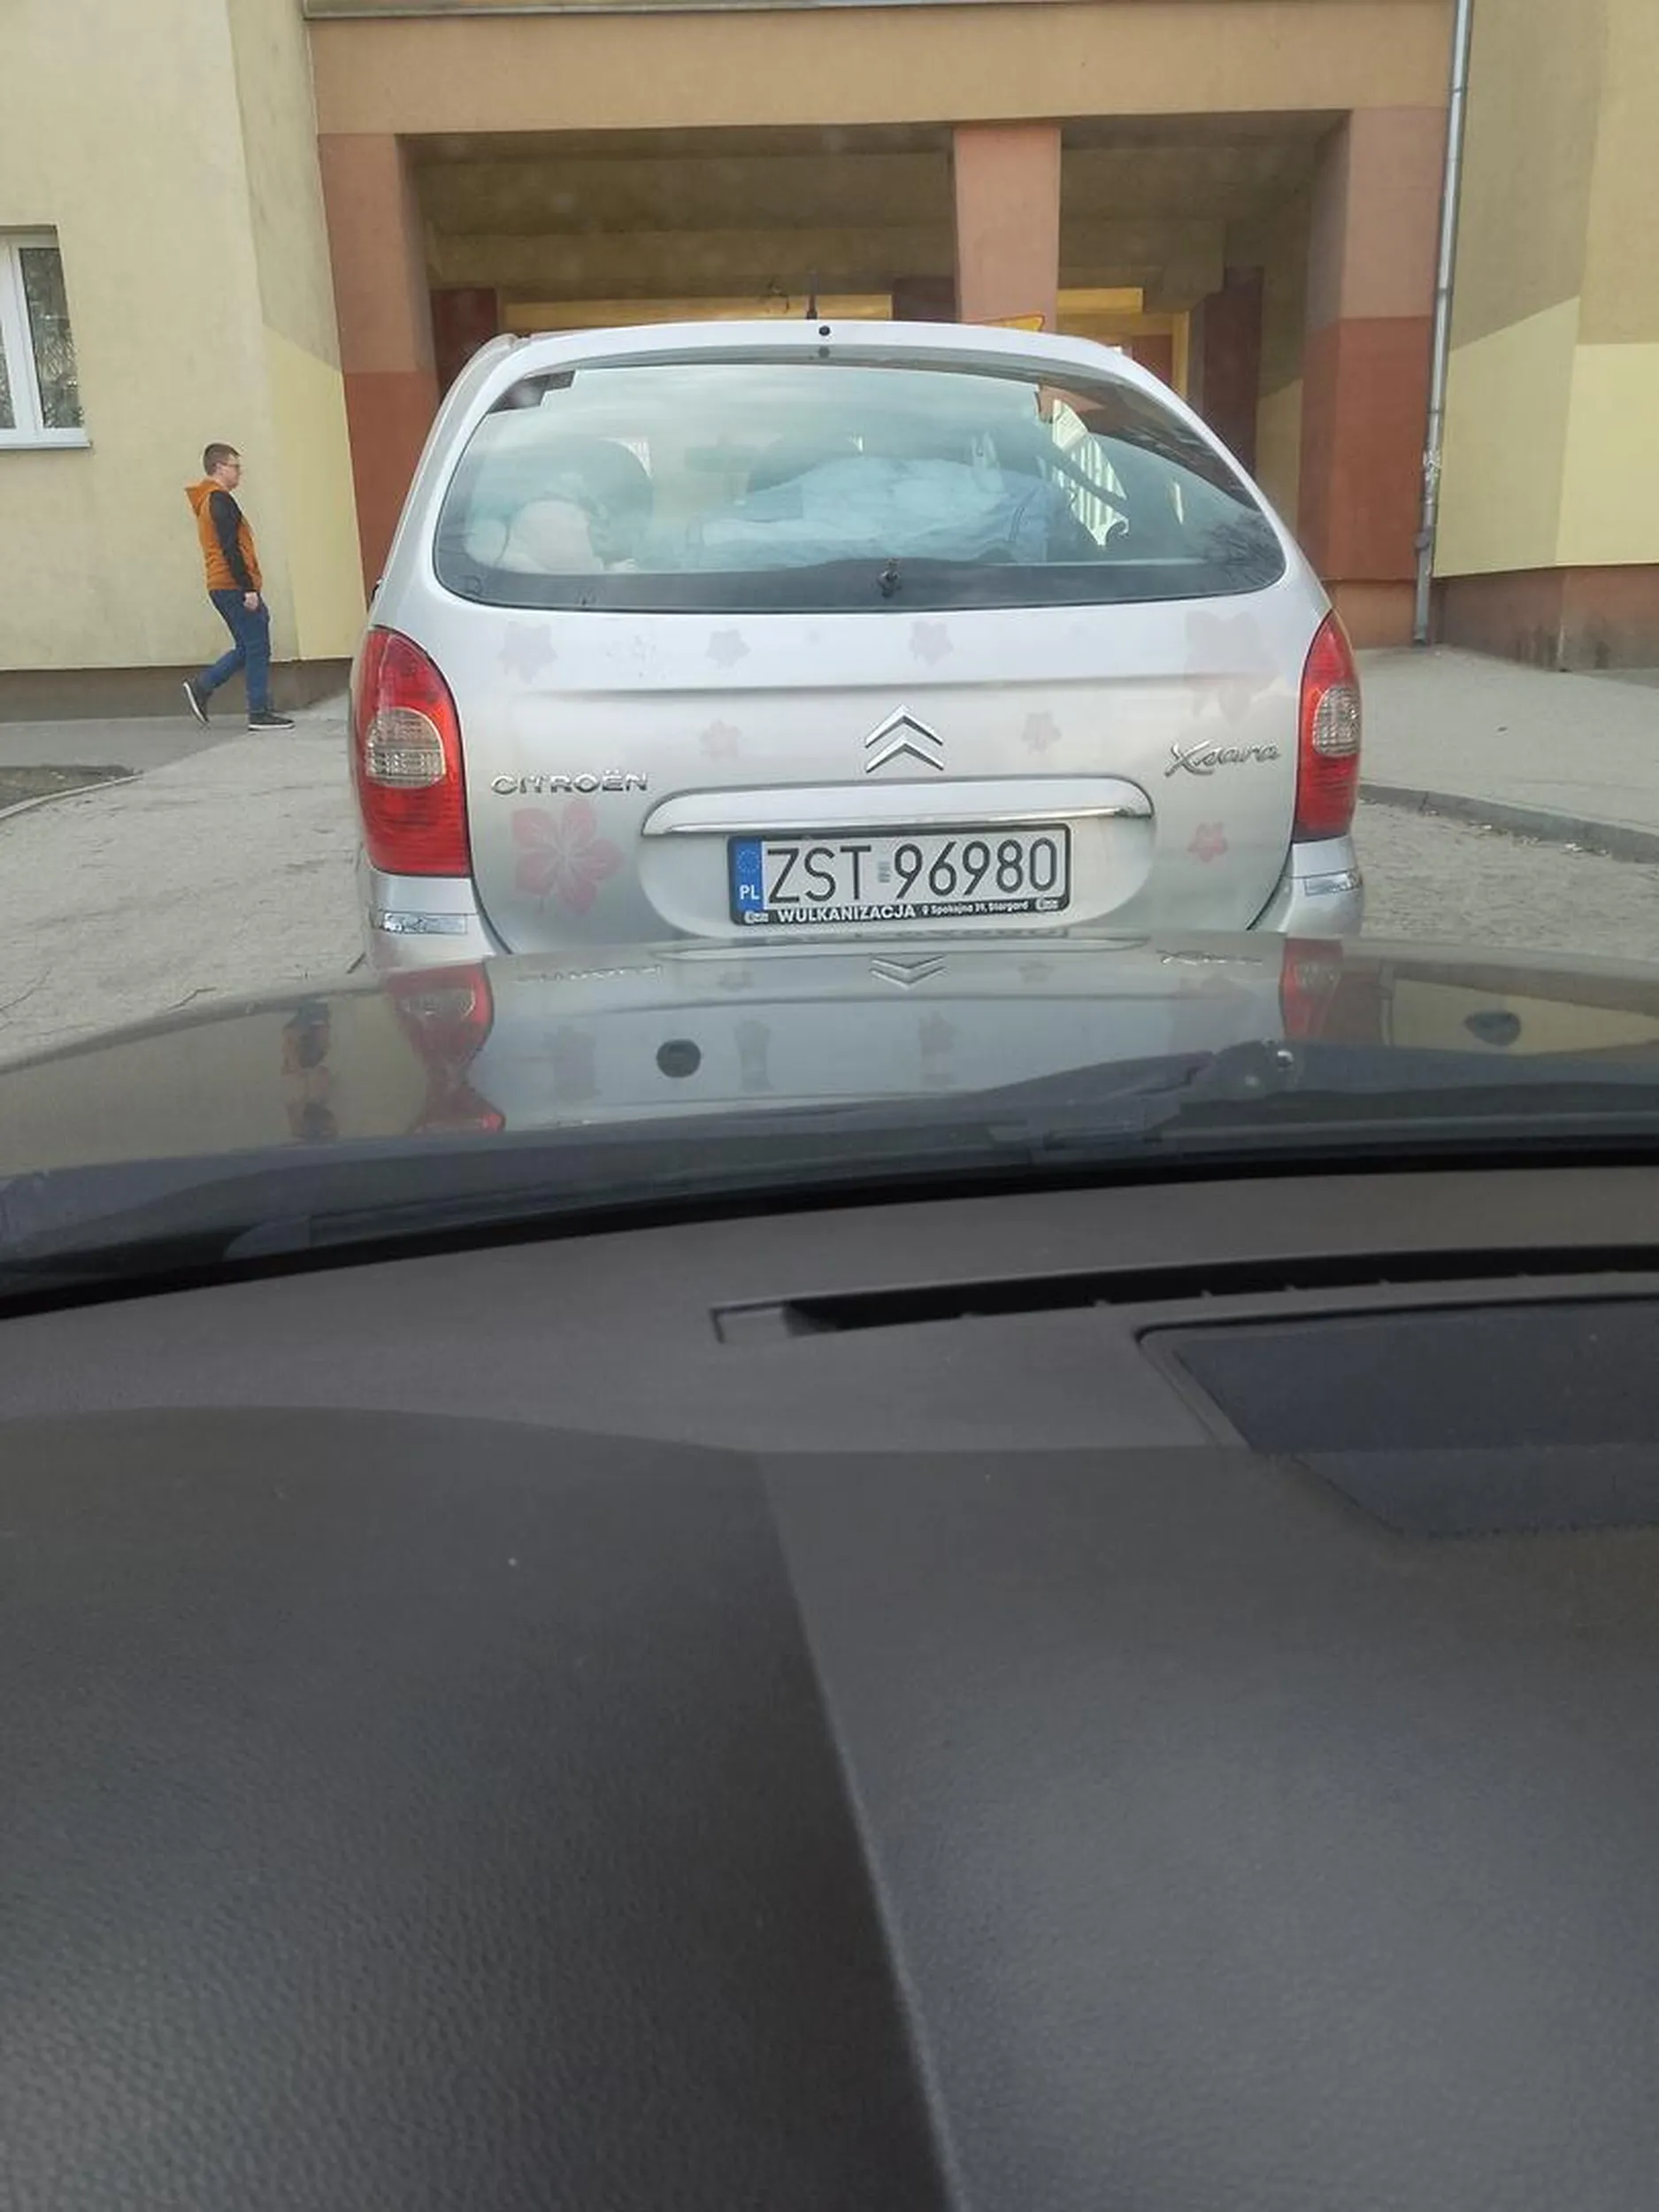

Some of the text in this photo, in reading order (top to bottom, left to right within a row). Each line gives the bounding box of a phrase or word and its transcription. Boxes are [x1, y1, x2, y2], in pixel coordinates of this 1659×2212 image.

[1164, 740, 1280, 778] Xsara
[491, 769, 648, 795] CITROËN
[767, 837, 1057, 904] ZST 96980
[739, 884, 761, 900] PL
[777, 904, 916, 923] WULKANIZACJA
